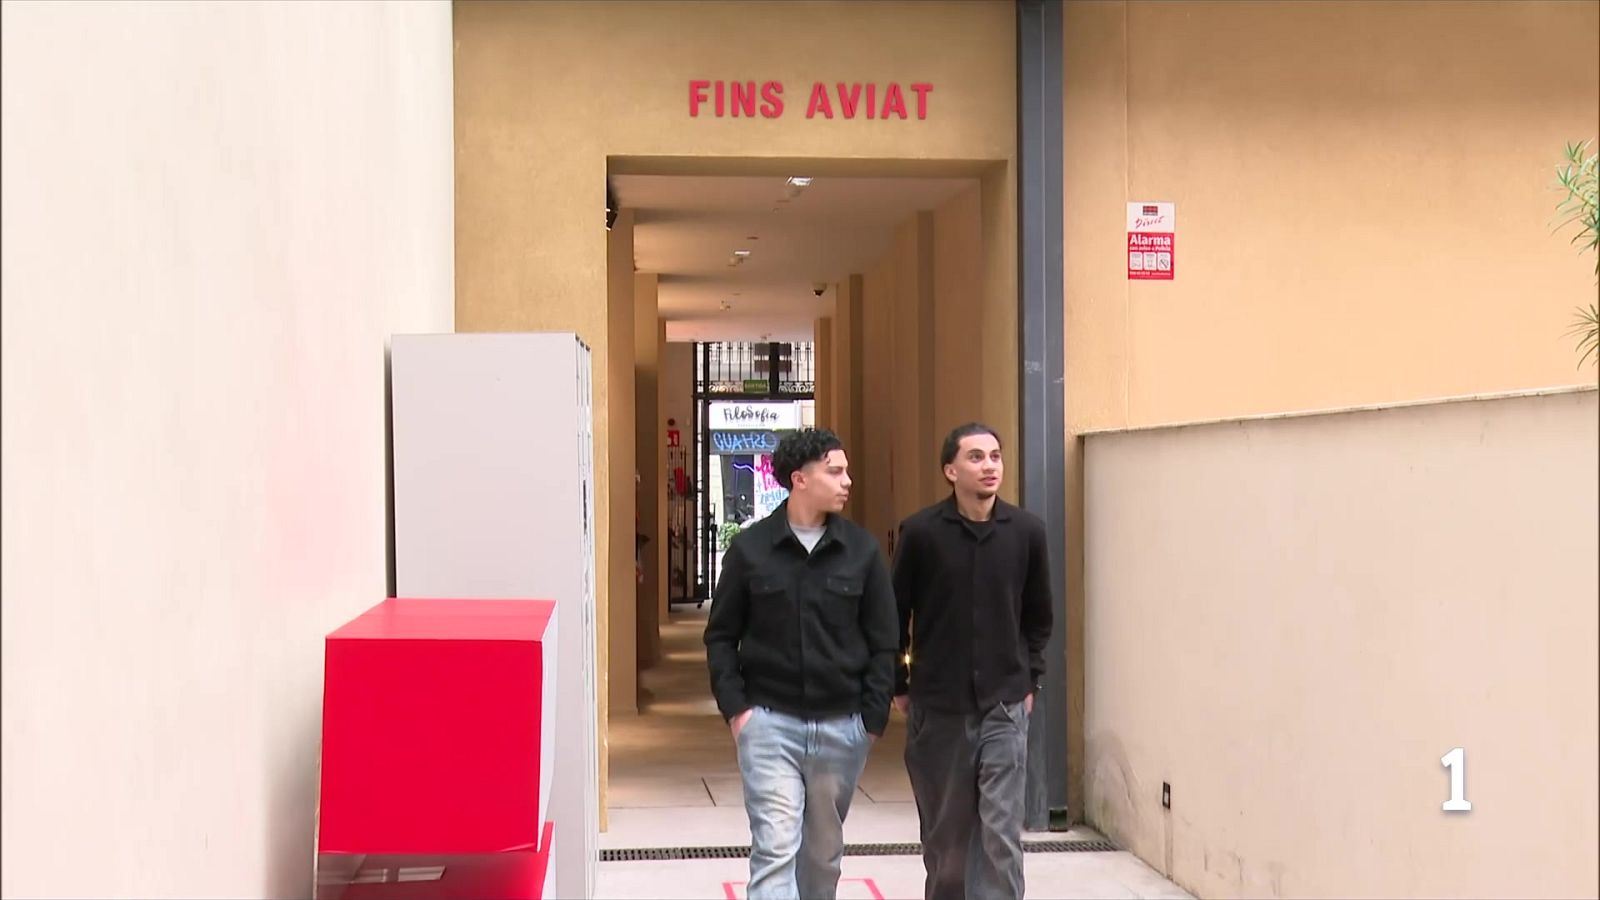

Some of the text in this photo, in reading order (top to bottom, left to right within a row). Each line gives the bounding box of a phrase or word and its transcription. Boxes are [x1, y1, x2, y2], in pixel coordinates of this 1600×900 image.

[689, 80, 934, 120] FINS AVIAT
[1129, 234, 1171, 246] Alarma
